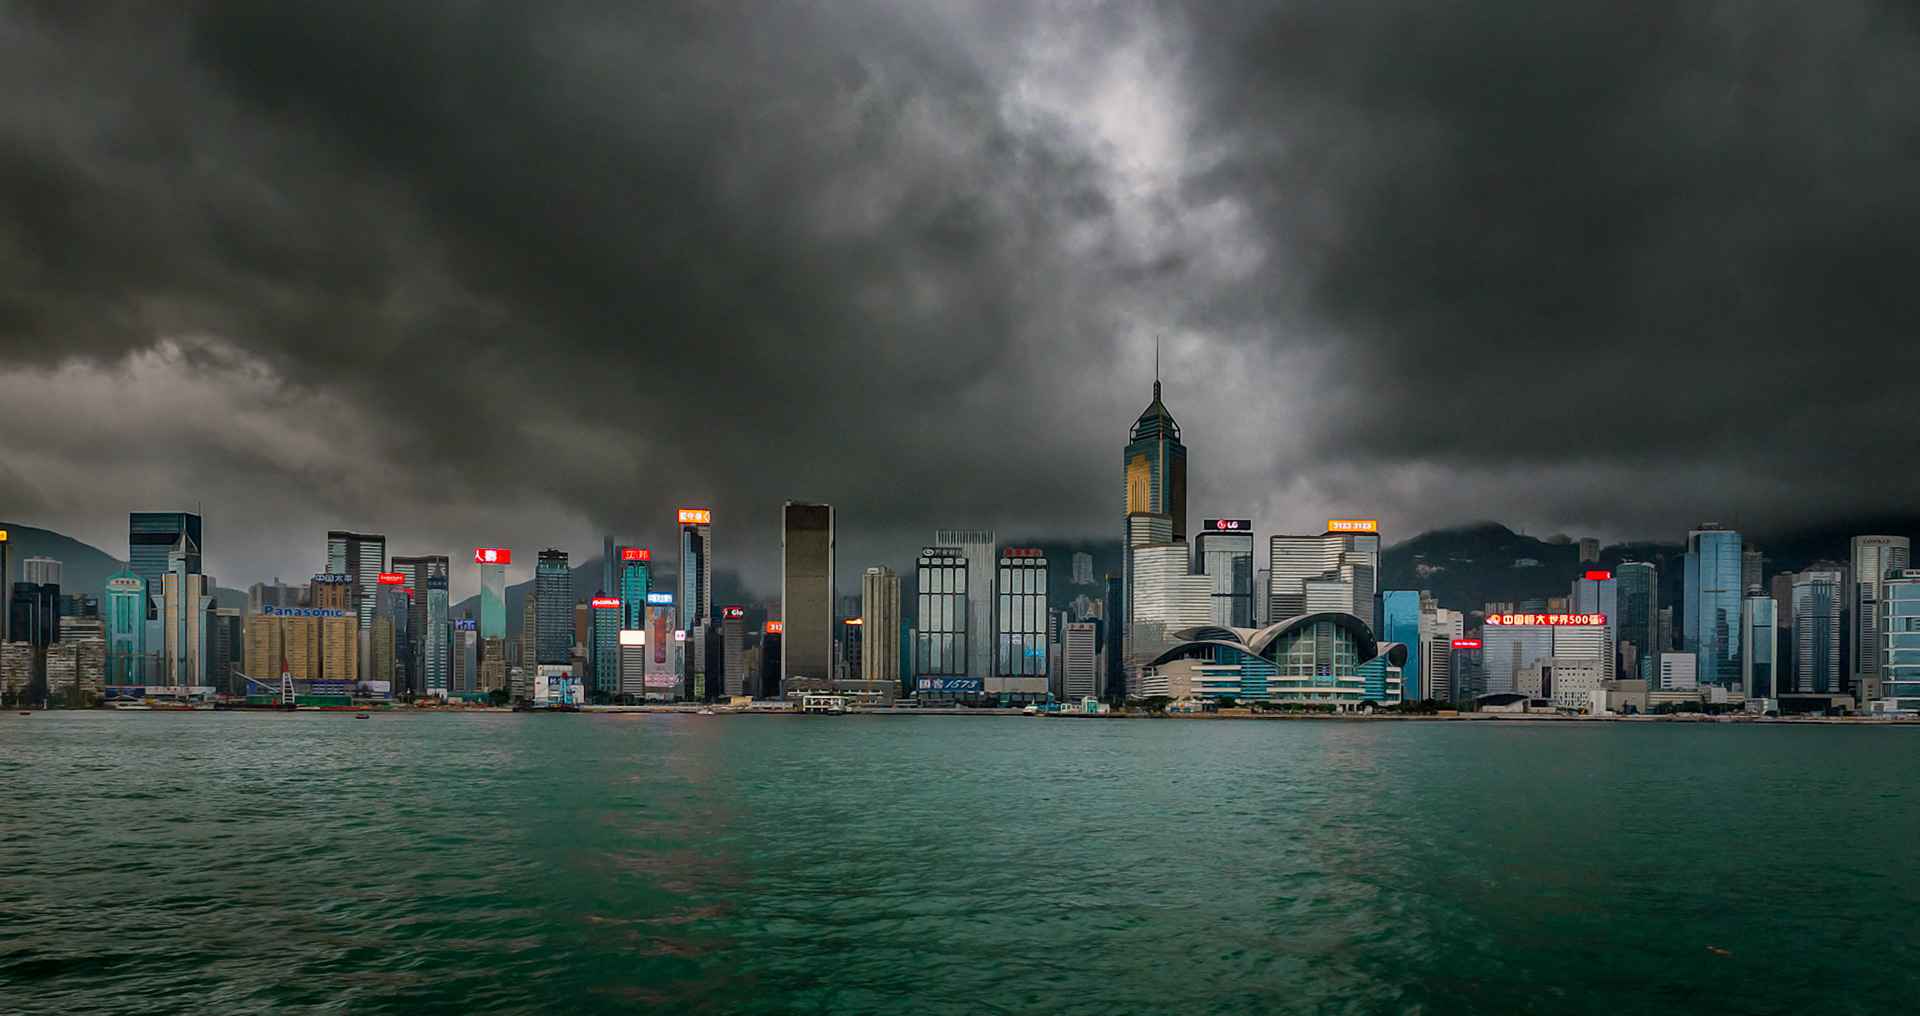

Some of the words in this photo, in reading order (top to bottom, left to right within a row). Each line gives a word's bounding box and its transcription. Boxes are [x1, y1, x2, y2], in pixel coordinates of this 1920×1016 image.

[1333, 522, 1352, 530] 3123
[1354, 522, 1372, 530] 3123
[264, 606, 343, 617] Panasonic
[945, 680, 977, 688] 1573
